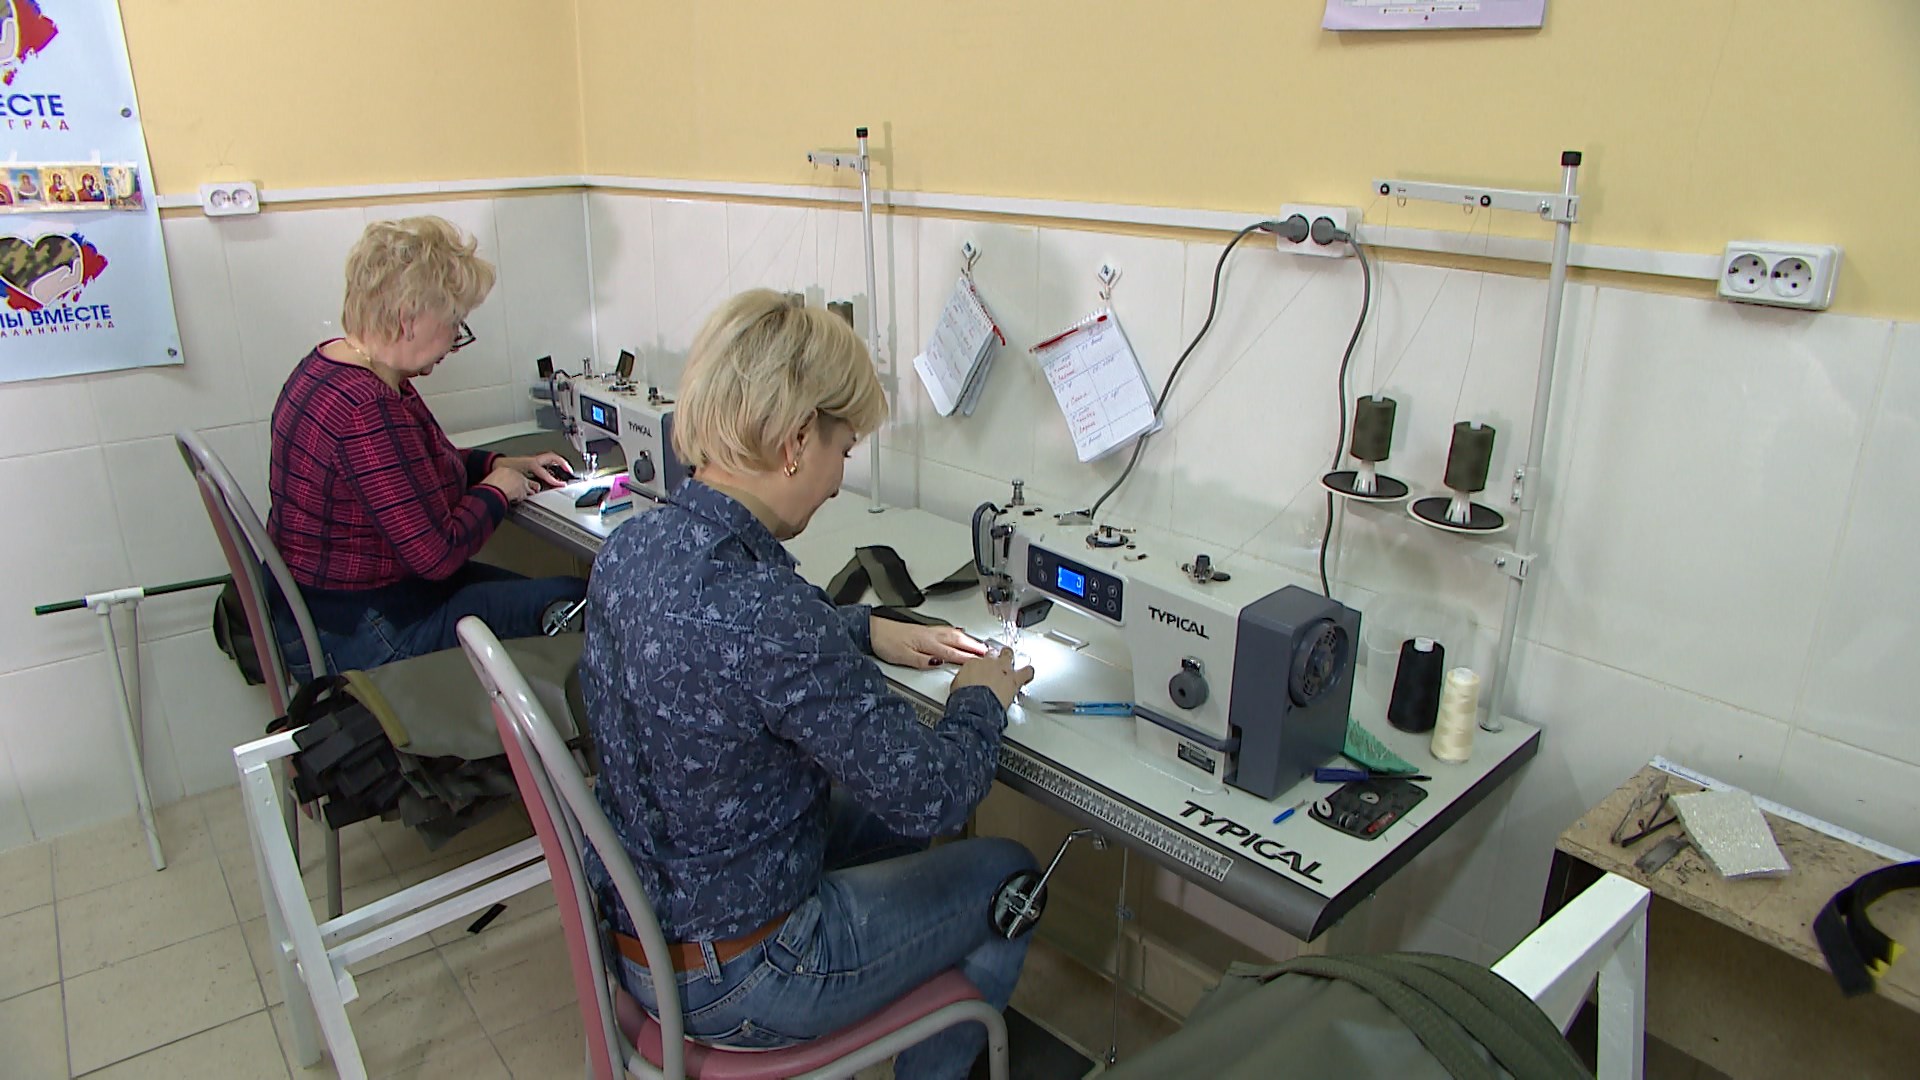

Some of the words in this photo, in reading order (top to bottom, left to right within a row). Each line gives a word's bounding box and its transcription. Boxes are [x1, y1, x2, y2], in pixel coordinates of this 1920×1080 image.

[0, 313, 23, 328] Ы
[30, 304, 111, 327] ВМЕСТЕ
[1148, 605, 1210, 640] TYPICAL
[1180, 800, 1323, 884] TYPICAL
